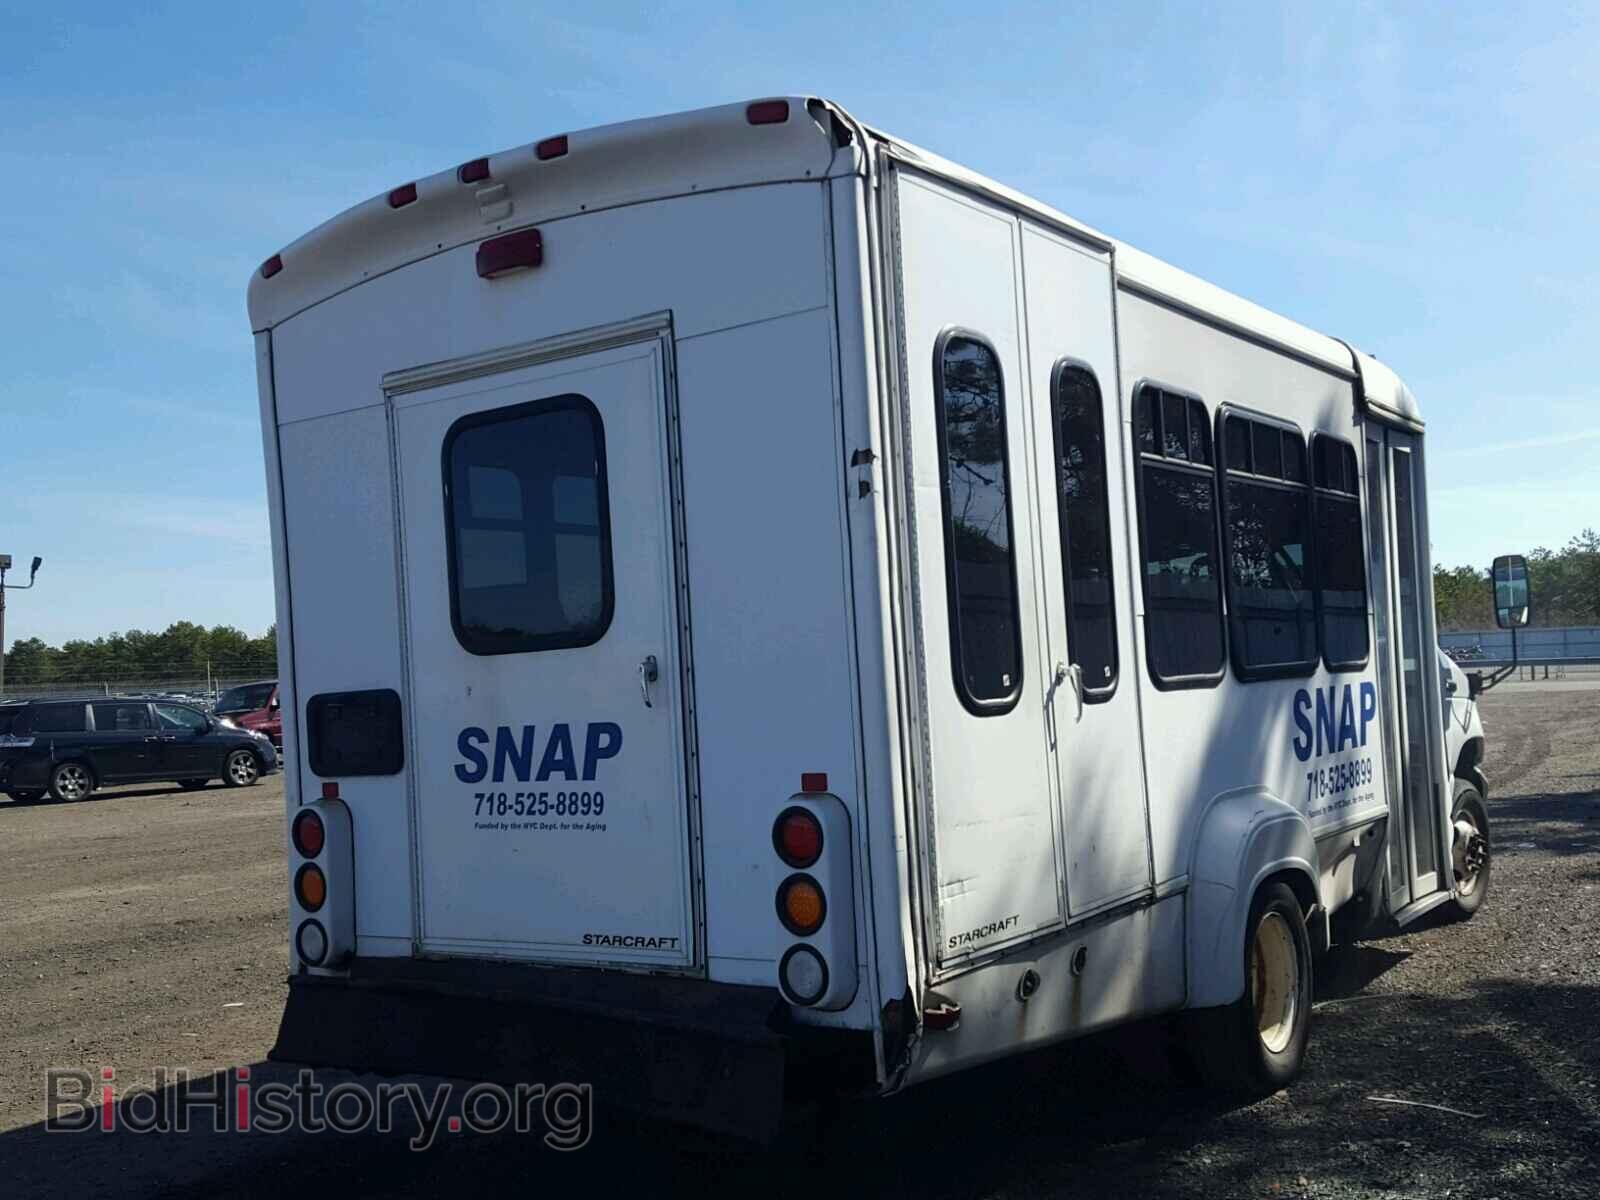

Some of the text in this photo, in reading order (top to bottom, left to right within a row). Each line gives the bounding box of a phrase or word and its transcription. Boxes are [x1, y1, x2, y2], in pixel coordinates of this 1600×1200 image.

[1293, 681, 1376, 762] SNAP
[454, 722, 623, 784] SNAP
[1307, 758, 1372, 801] 718-525-8899
[474, 791, 604, 816] 718-525-8899
[475, 822, 499, 830] Funded
[501, 822, 509, 831] by
[510, 822, 521, 830] the
[560, 822, 570, 830] for
[572, 822, 583, 830] the
[585, 823, 606, 832] Aging
[582, 933, 679, 949] STARCRAFT
[948, 914, 1020, 949] STARCRAFT
